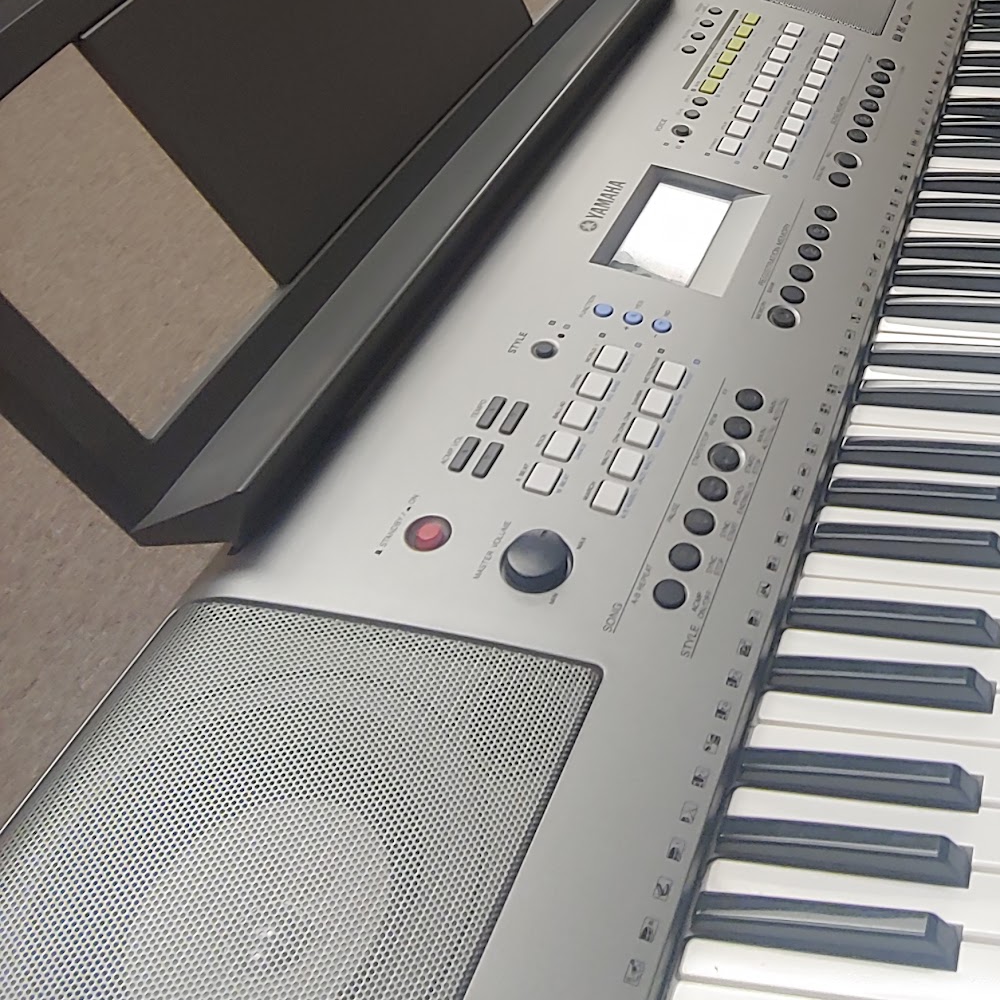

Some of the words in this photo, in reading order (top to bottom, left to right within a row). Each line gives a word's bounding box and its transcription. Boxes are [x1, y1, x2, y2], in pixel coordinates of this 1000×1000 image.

[654, 118, 668, 132] VOICE
[585, 180, 627, 219] YAMAHA
[507, 332, 528, 354] STYLE
[470, 398, 488, 419] TEMPO
[378, 516, 405, 549] STANDBY
[408, 493, 420, 506] ON
[472, 549, 495, 580] MASTER
[491, 519, 512, 550] VOLUME
[602, 601, 623, 633] SONG
[680, 623, 700, 659] STYLE
